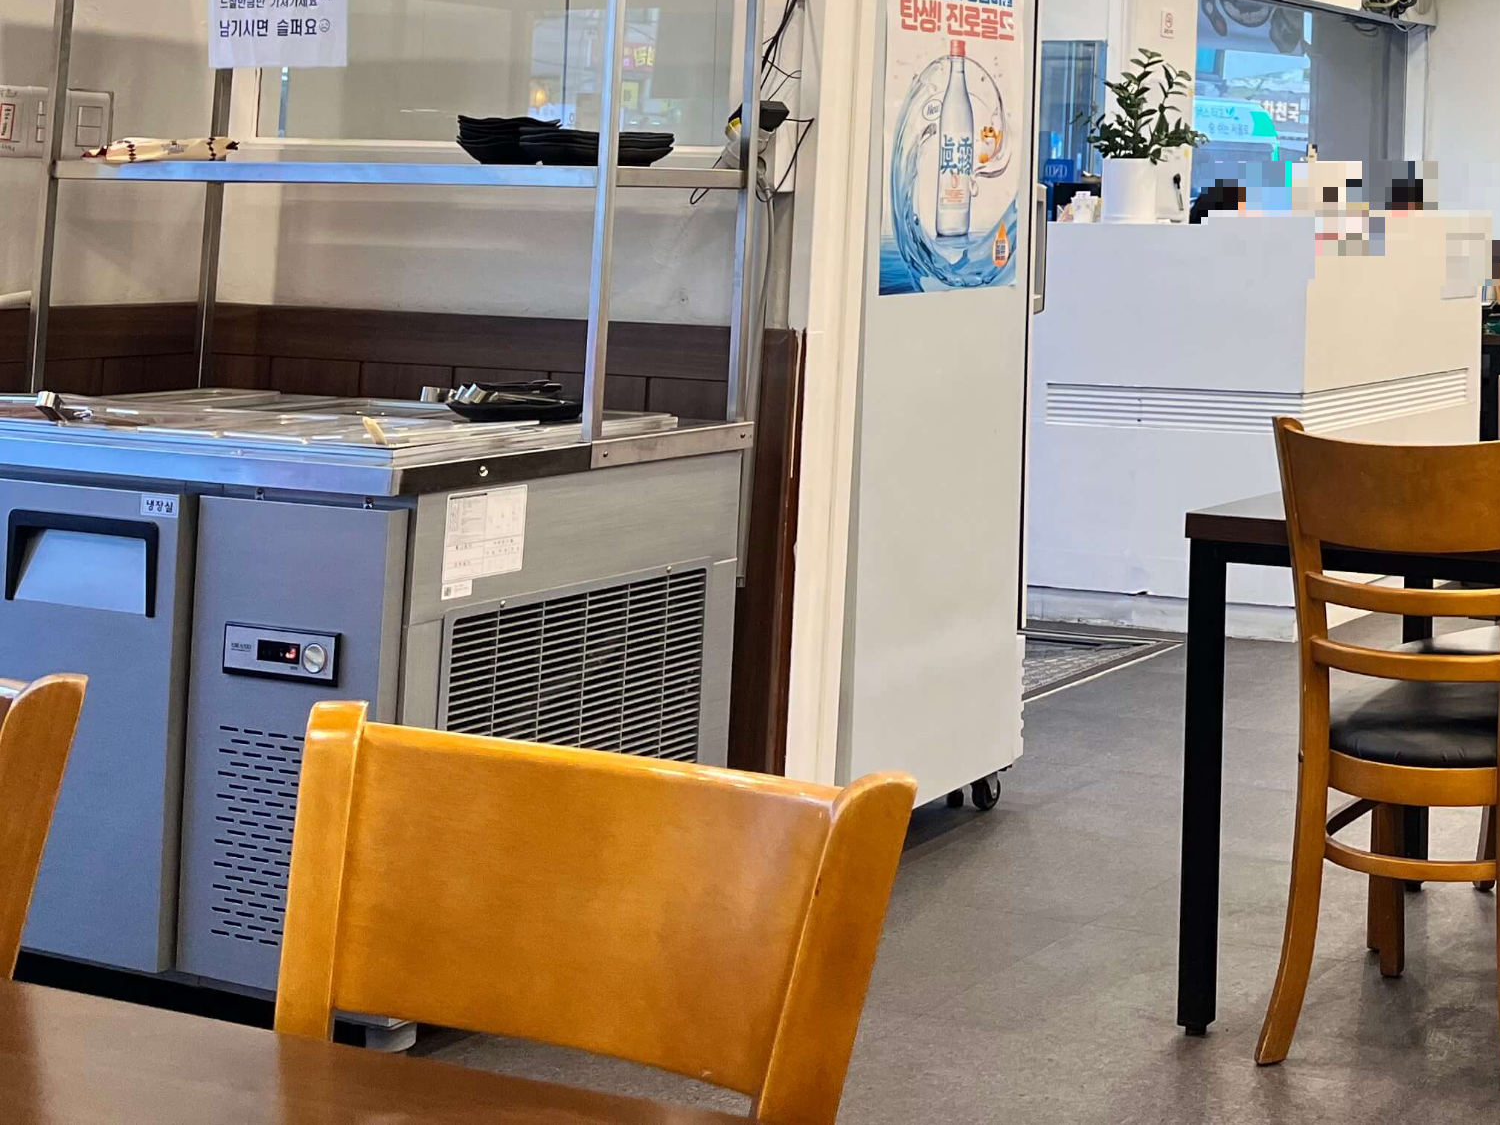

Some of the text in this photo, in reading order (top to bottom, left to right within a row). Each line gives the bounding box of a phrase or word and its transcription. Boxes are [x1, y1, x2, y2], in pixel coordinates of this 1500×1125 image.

[219, 18, 317, 37] 남기시면 슬퍼요
[946, 3, 1015, 41] 진로골드
[146, 499, 173, 513] 냉장실
